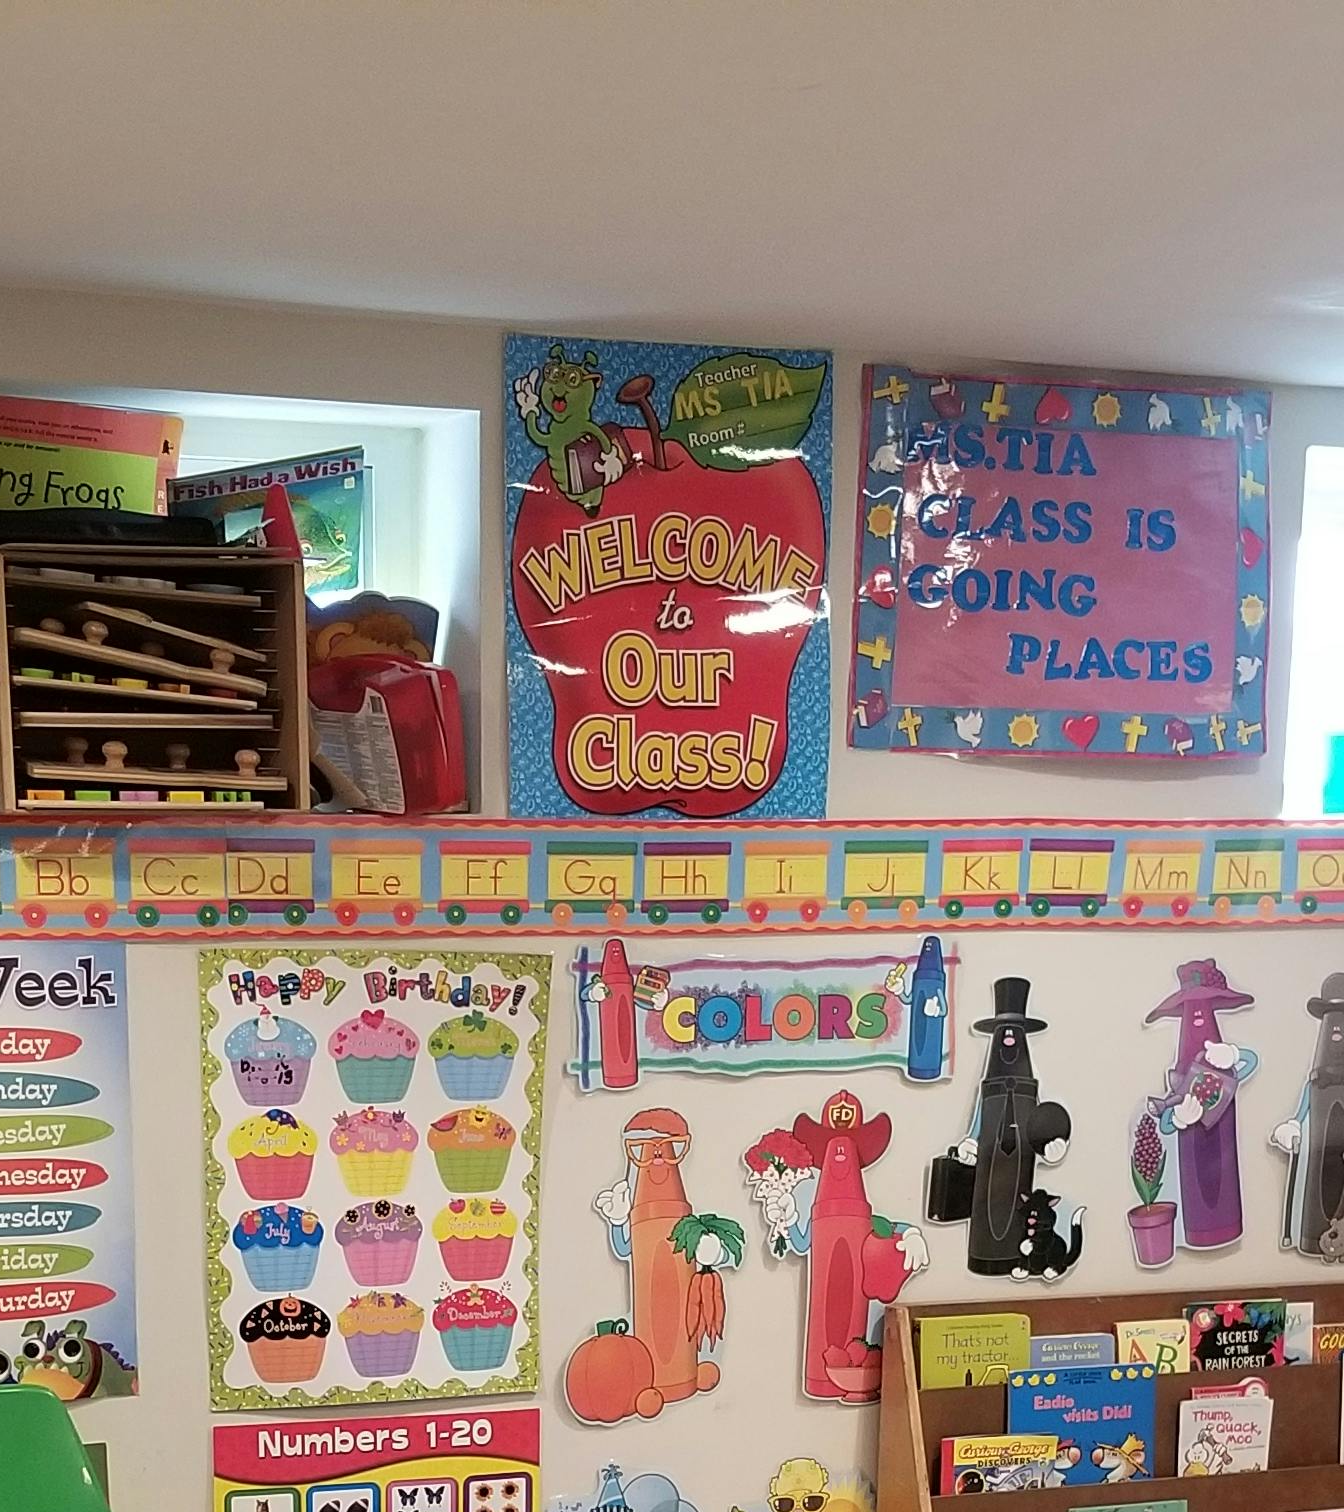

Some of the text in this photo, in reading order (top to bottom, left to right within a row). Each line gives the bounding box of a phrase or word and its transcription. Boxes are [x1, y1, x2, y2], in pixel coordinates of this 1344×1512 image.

[674, 371, 795, 422] MS TIA
[694, 362, 758, 389] Teacher
[172, 457, 356, 502] Fish Had a Wish
[917, 494, 1177, 553] CLASS IS
[519, 511, 819, 613] WELCOME
[656, 587, 695, 631] to
[907, 564, 1098, 618] GOING
[601, 629, 735, 707] Our
[1005, 632, 1214, 684] PLACES
[567, 712, 777, 791] Class!
[227, 965, 528, 1016] Happy Birthday!
[661, 992, 889, 1044] COLORS
[831, 1106, 854, 1122] FD
[264, 1220, 292, 1245] July
[262, 1318, 309, 1335] October
[1215, 1329, 1259, 1345] SECRETS
[1205, 1354, 1266, 1371] RAIN FOREST
[1062, 1404, 1133, 1424] visits Didi
[256, 1418, 493, 1460] Numbers 1-20
